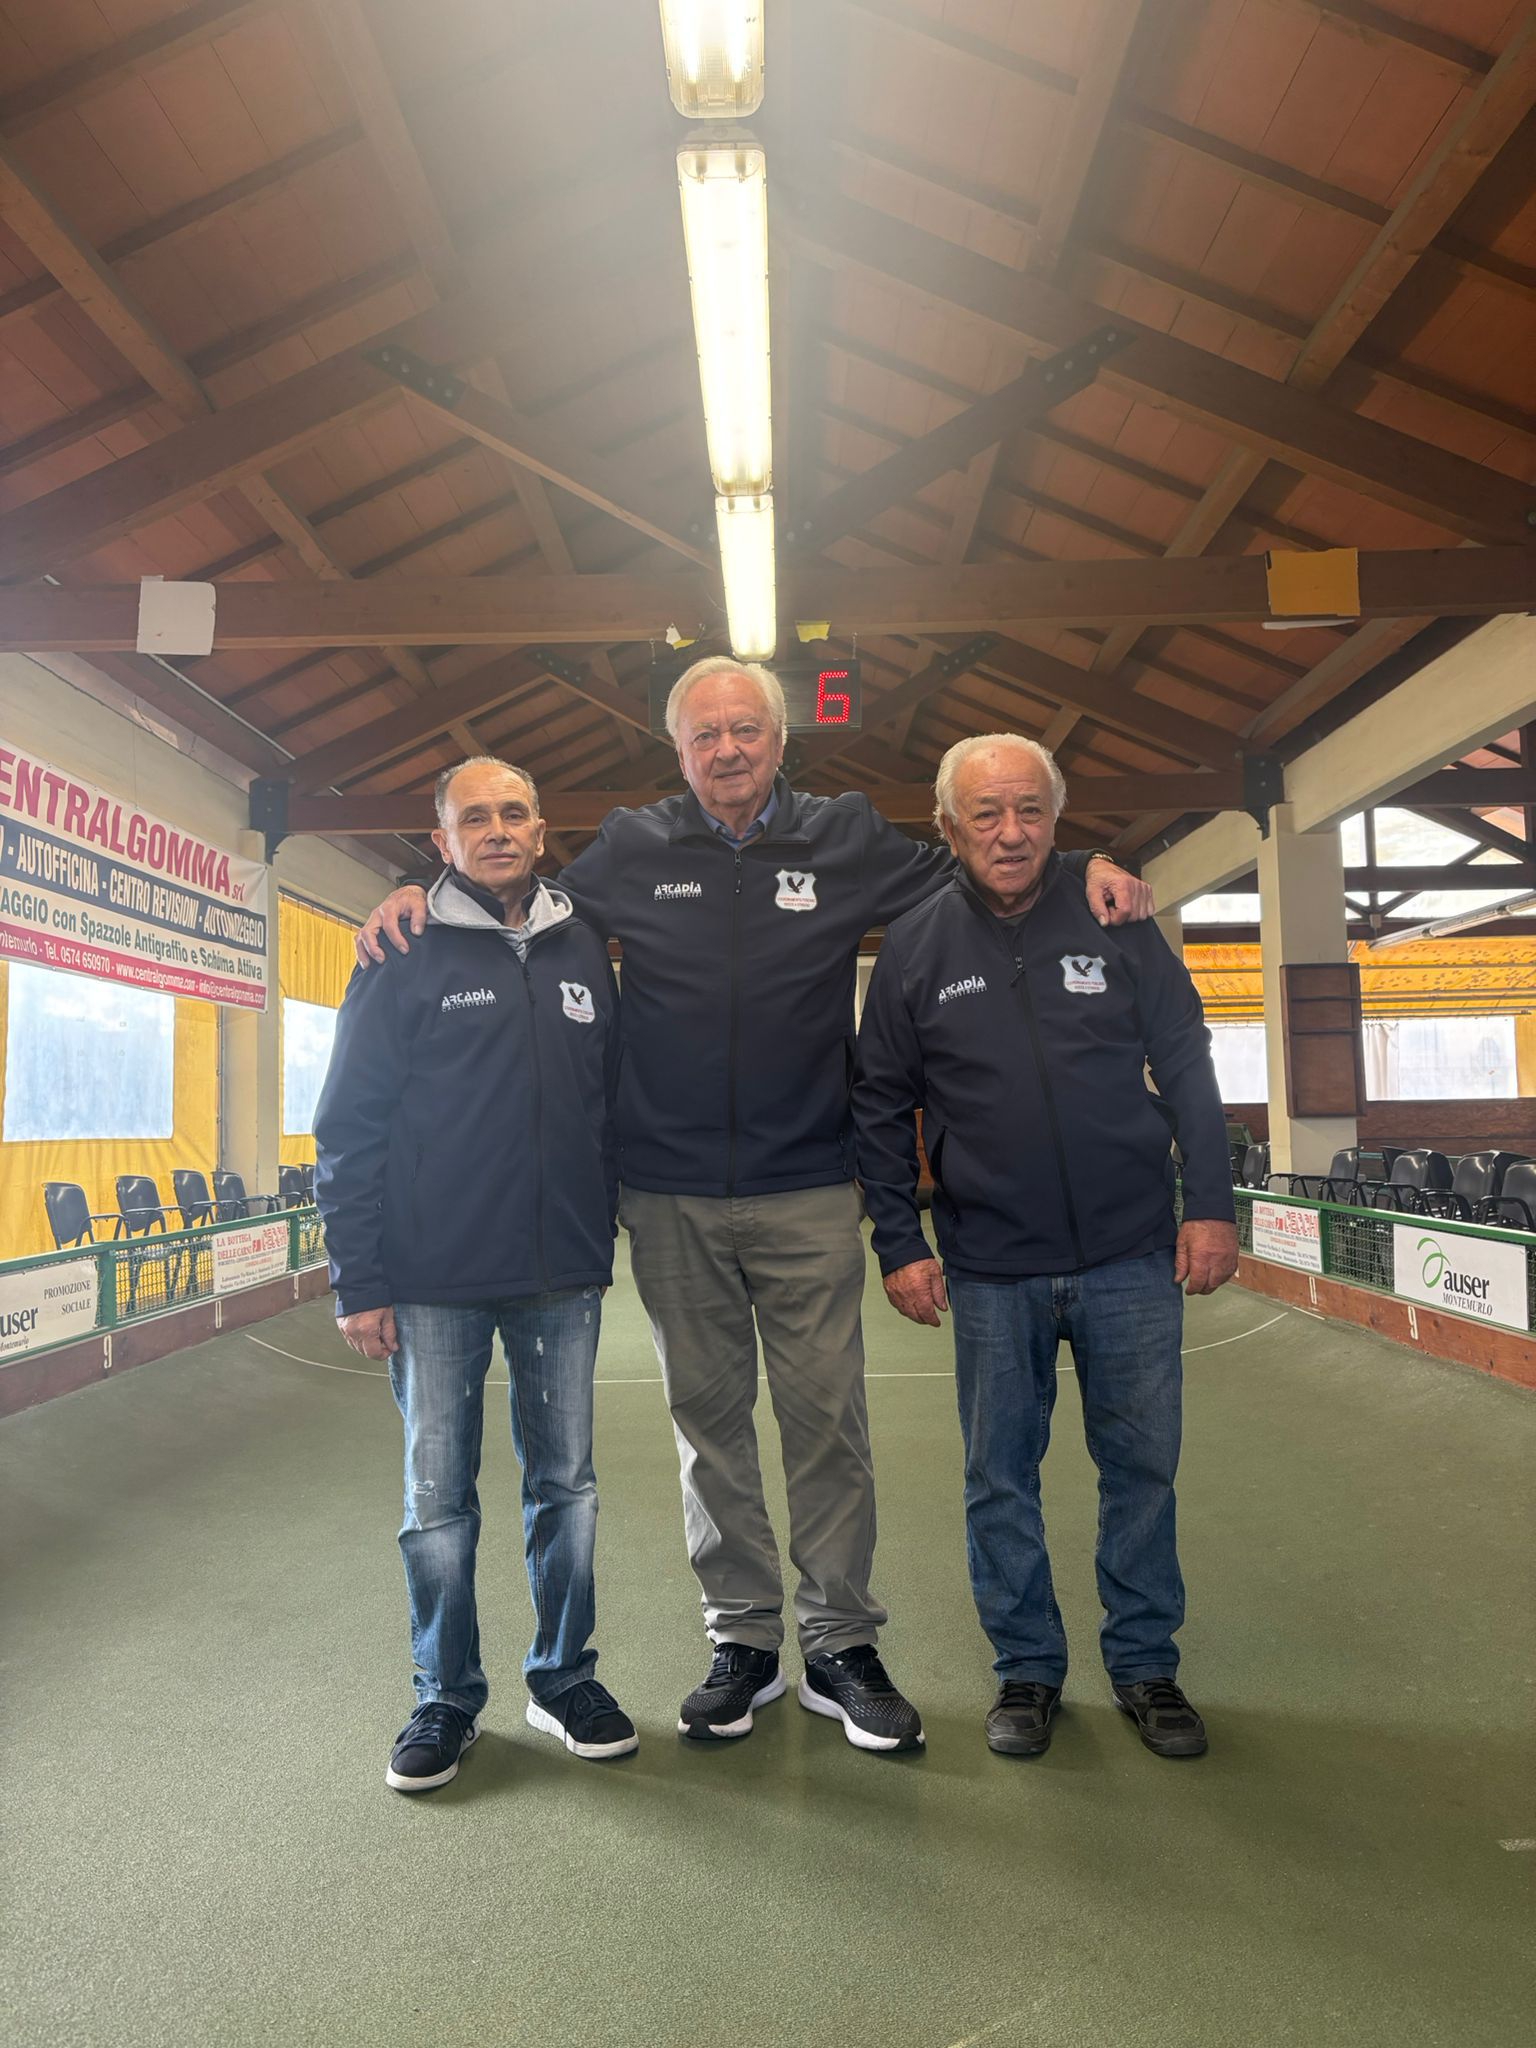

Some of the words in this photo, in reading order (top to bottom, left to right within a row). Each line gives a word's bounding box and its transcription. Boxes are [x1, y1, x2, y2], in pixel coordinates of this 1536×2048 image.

[816, 671, 850, 723] 6
[16, 833, 99, 897] AUTOFFICINA
[110, 868, 151, 915] CENTRO
[152, 884, 199, 930] REVISIONI
[0, 887, 48, 924] AGGIO
[53, 909, 76, 932] con
[80, 912, 131, 948] Spazzole
[135, 929, 187, 962] Antigraffio
[191, 950, 197, 964] e
[237, 958, 262, 980] Attiva
[44, 941, 60, 961] Tel.
[60, 946, 81, 966] 0574
[82, 951, 111, 973] 650970
[44, 1280, 91, 1300] PROMOZIONE
[1444, 1270, 1490, 1300] auser
[61, 1298, 91, 1315] SOCIALE
[1442, 1293, 1492, 1316] MONTEMURLO
[0, 1307, 38, 1337] user
[103, 1334, 112, 1369] 9
